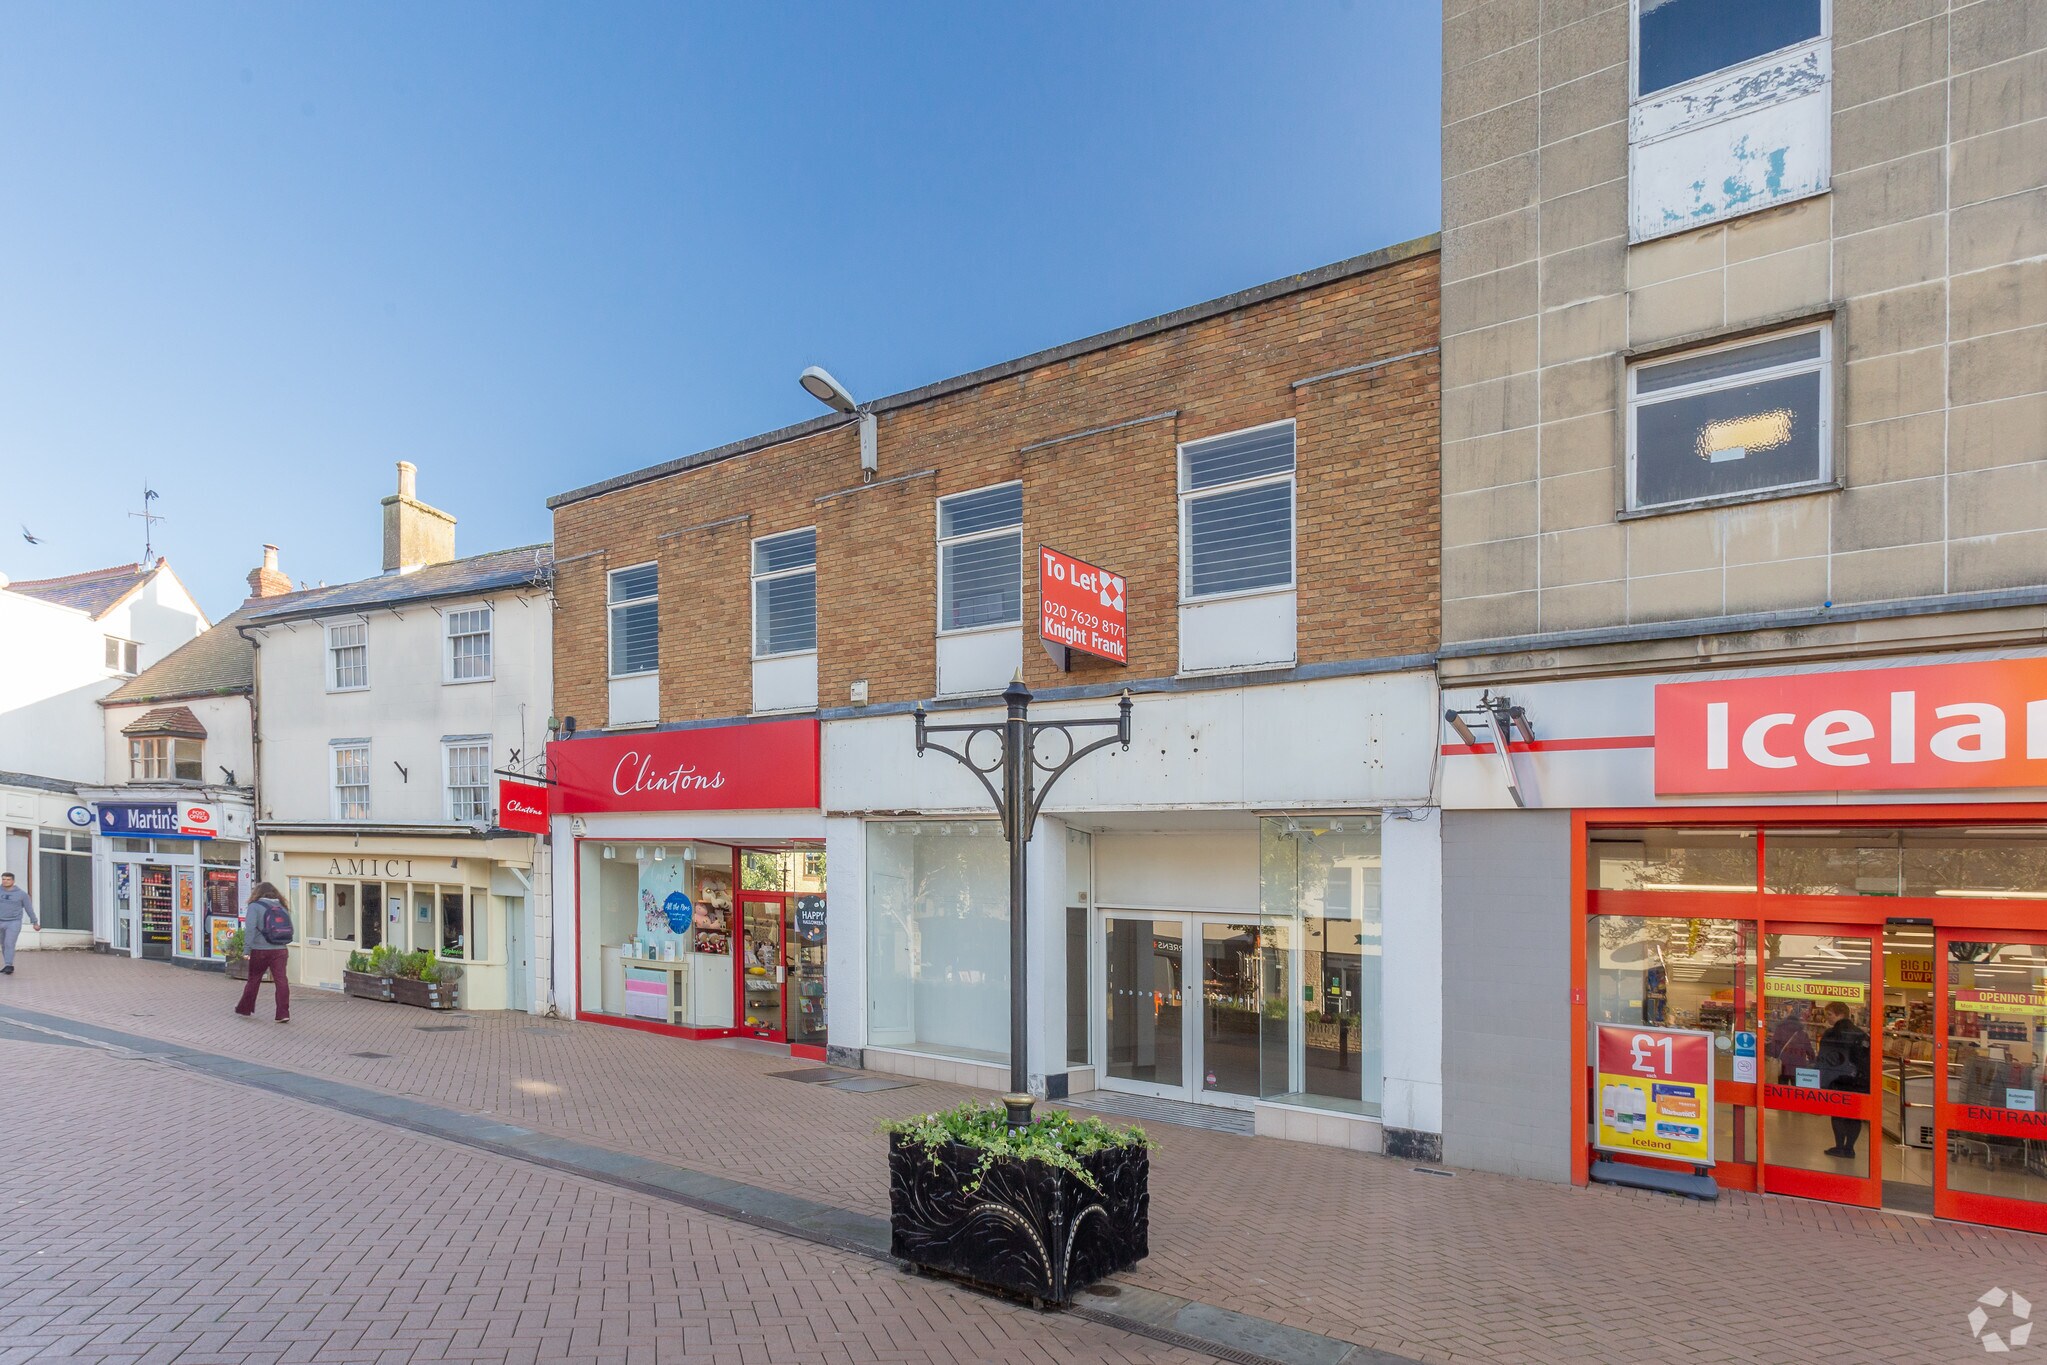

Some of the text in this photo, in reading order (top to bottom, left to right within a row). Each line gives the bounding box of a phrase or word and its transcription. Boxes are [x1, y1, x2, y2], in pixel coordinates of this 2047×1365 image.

[1044, 553, 1098, 594] To Let
[1044, 600, 1125, 638] 020 7629 8171
[1044, 616, 1125, 657] Knight Frank
[1707, 690, 2047, 770] Icela
[612, 751, 725, 797] Clintons
[190, 813, 208, 821] OFFICE
[506, 799, 543, 816] Clintons
[128, 808, 178, 830] Martin's
[328, 858, 413, 878] AMICI
[802, 911, 825, 921] HAPPY
[1900, 960, 1919, 971] BIG
[1902, 971, 1923, 981] LOW
[1774, 982, 1802, 993] DEALS
[1804, 984, 1824, 994] LOW
[1826, 986, 1860, 997] PRICES
[1979, 991, 2026, 1004] OPENING
[1630, 1034, 1673, 1075] £1
[1764, 1086, 1852, 1105] ENTRANCE
[1632, 1137, 1672, 1150] Iceland
